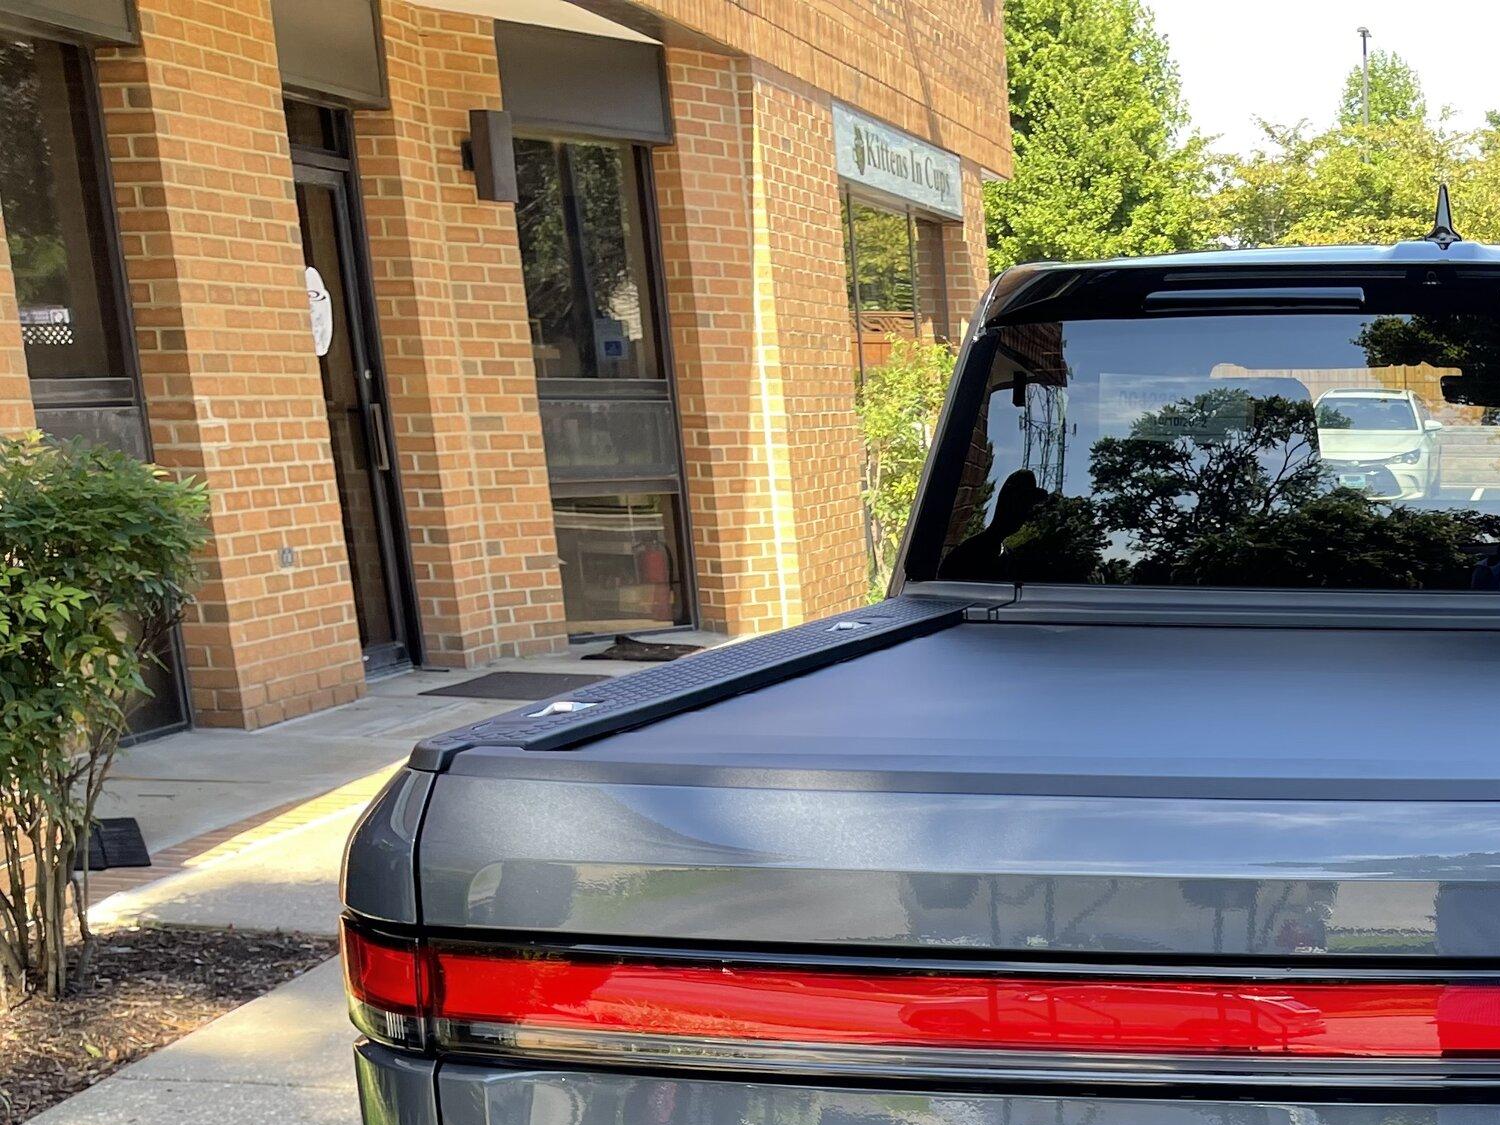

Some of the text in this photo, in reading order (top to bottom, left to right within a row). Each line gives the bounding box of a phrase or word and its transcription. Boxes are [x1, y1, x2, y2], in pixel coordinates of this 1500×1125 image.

[865, 129, 950, 202] Kittens In Cups
